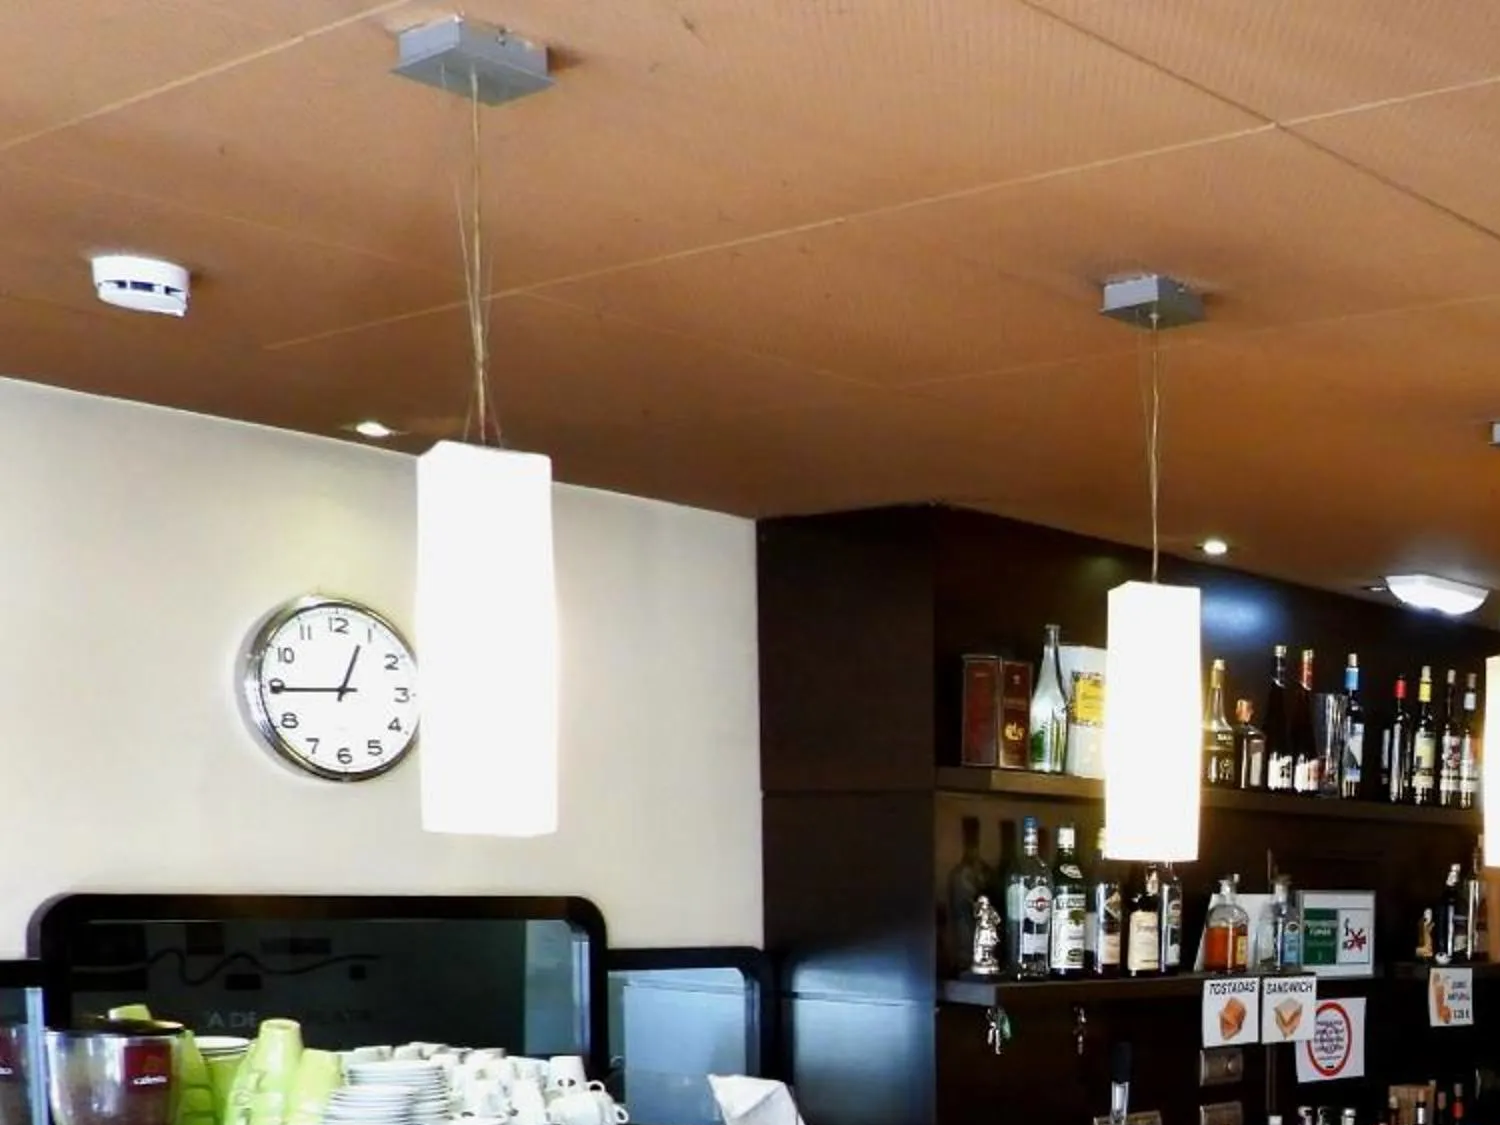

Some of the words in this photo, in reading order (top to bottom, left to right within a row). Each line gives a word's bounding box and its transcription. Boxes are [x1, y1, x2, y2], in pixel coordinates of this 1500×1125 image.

[300, 624, 313, 641] 11
[328, 616, 350, 635] 12
[277, 647, 296, 664] 10
[384, 653, 400, 671] 2
[394, 686, 411, 704] 3
[280, 712, 300, 730] 8
[387, 717, 403, 733] 4
[304, 737, 320, 755] 7
[367, 739, 384, 757] 5
[336, 747, 353, 765] 6
[1208, 981, 1257, 996] TOSTADAS
[1265, 981, 1314, 996] SANDWICH
